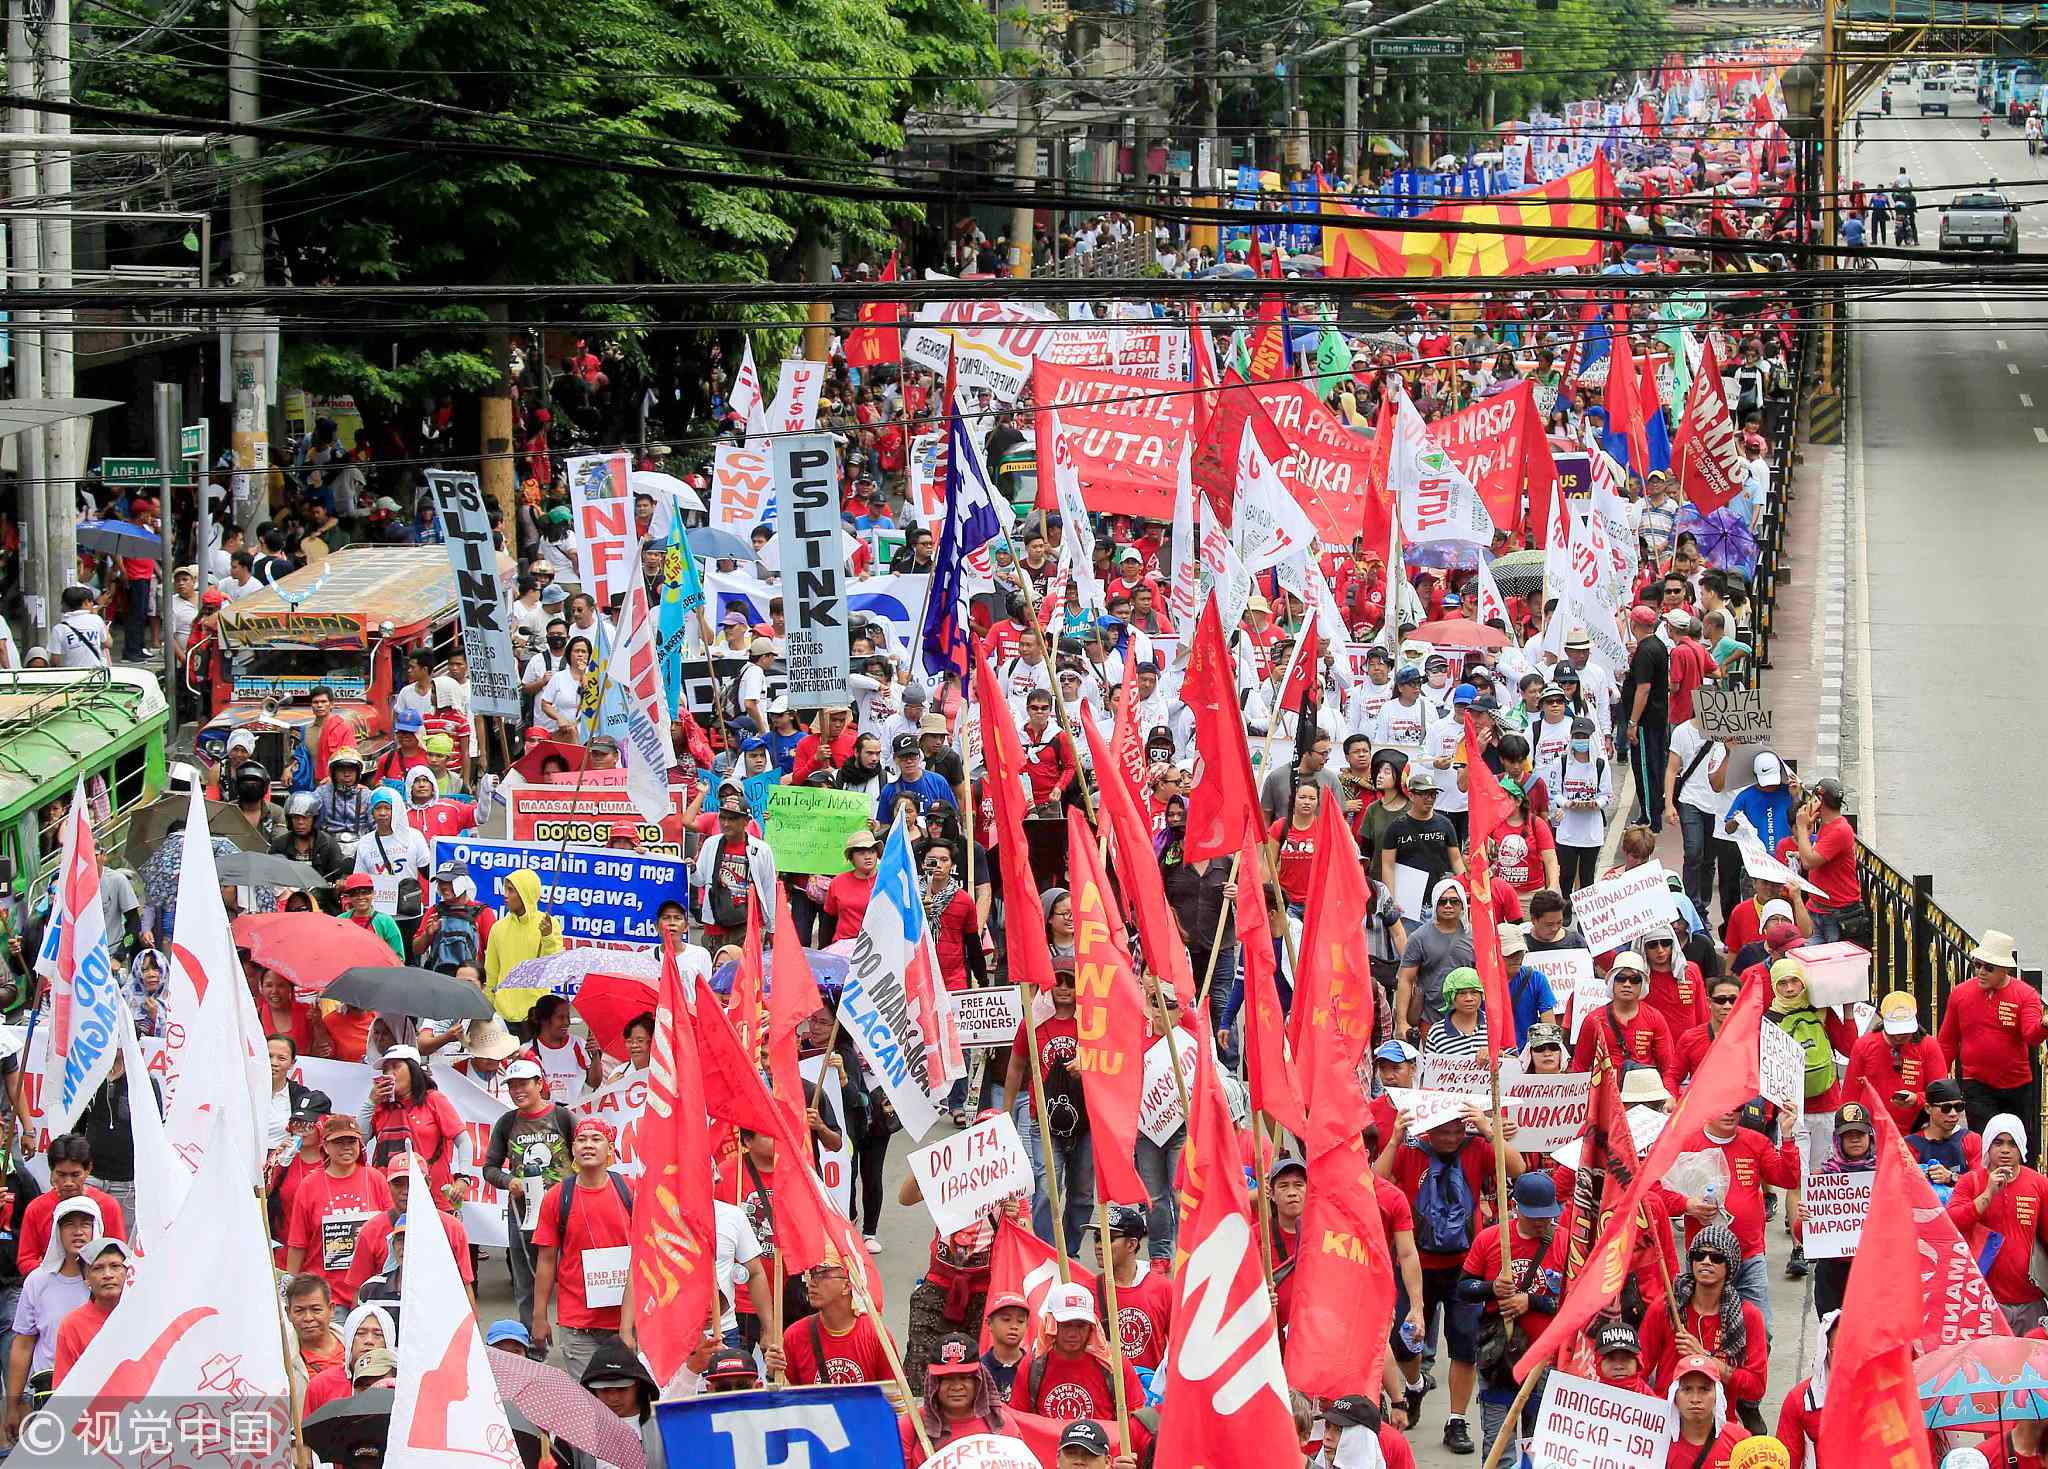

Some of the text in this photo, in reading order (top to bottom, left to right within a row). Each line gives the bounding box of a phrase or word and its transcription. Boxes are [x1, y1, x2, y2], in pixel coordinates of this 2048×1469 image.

[1379, 44, 1409, 53] Padre
[784, 370, 811, 432] UFSW
[717, 452, 771, 524] CWNP
[789, 449, 842, 629] PSLINK
[434, 479, 503, 632] PSLINK
[67, 631, 98, 645] FW
[787, 631, 813, 643] PUBLIC
[788, 643, 823, 657] SERVICES
[789, 656, 812, 669] LABOR
[789, 666, 839, 681] INDEPENDENT
[789, 678, 847, 694] CONFEDERATION
[1700, 710, 1772, 734] IBASURA!
[1767, 807, 1775, 833] YOUNG
[537, 824, 591, 841] DONG
[453, 845, 675, 884] Organisahin ang mga
[493, 876, 643, 912] Mggagawa,
[1571, 885, 1600, 903] WAGE
[1576, 873, 1664, 917] RATIONALIZATION
[571, 915, 616, 937] mga
[960, 995, 1006, 1009] FREE ALL
[959, 1006, 1011, 1020] POLITICAL
[955, 1017, 1017, 1032] PRISONERS!
[516, 1133, 561, 1145] CRANK UP
[930, 1145, 952, 1178] DO
[941, 1151, 1016, 1206] IBASURA!
[1807, 1175, 1850, 1188] URING
[1807, 1201, 1870, 1216] HUKBONG
[1840, 1247, 1857, 1256] UH
[586, 1269, 629, 1281] END EN
[1602, 1327, 1635, 1344] PANAMA
[1554, 1386, 1666, 1434] MANGGAGAWA
